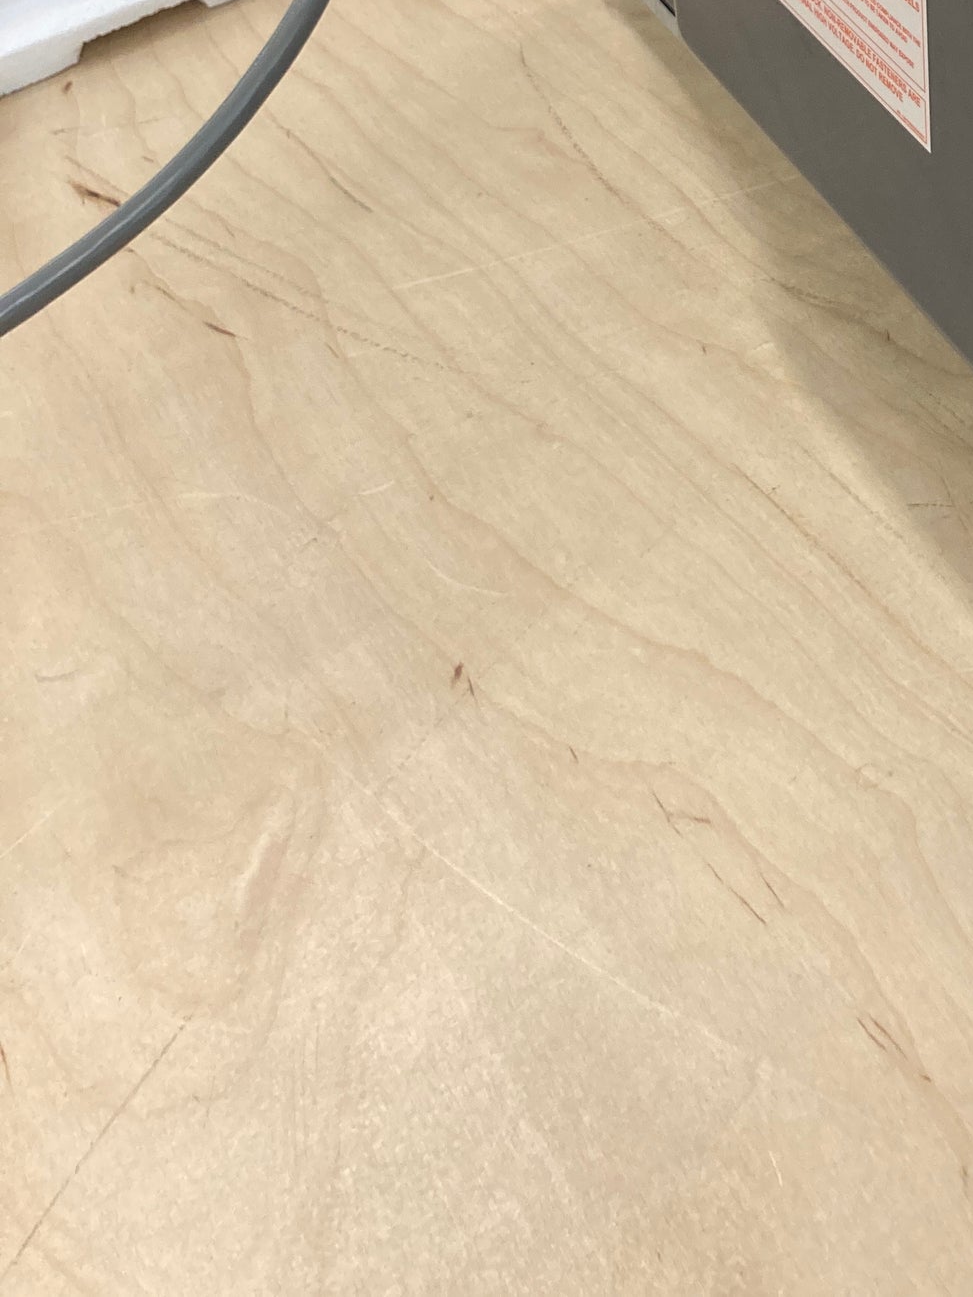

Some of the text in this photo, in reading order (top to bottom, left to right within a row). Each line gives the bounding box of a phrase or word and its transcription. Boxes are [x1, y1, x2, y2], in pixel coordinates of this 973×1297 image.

[824, 5, 871, 59] NON-REMOVABLE
[873, 53, 907, 94] FASTENERS
[908, 88, 920, 107] ARE
[856, 48, 865, 64] DO
[866, 58, 877, 77] NOT
[879, 71, 903, 103] REMOVE
